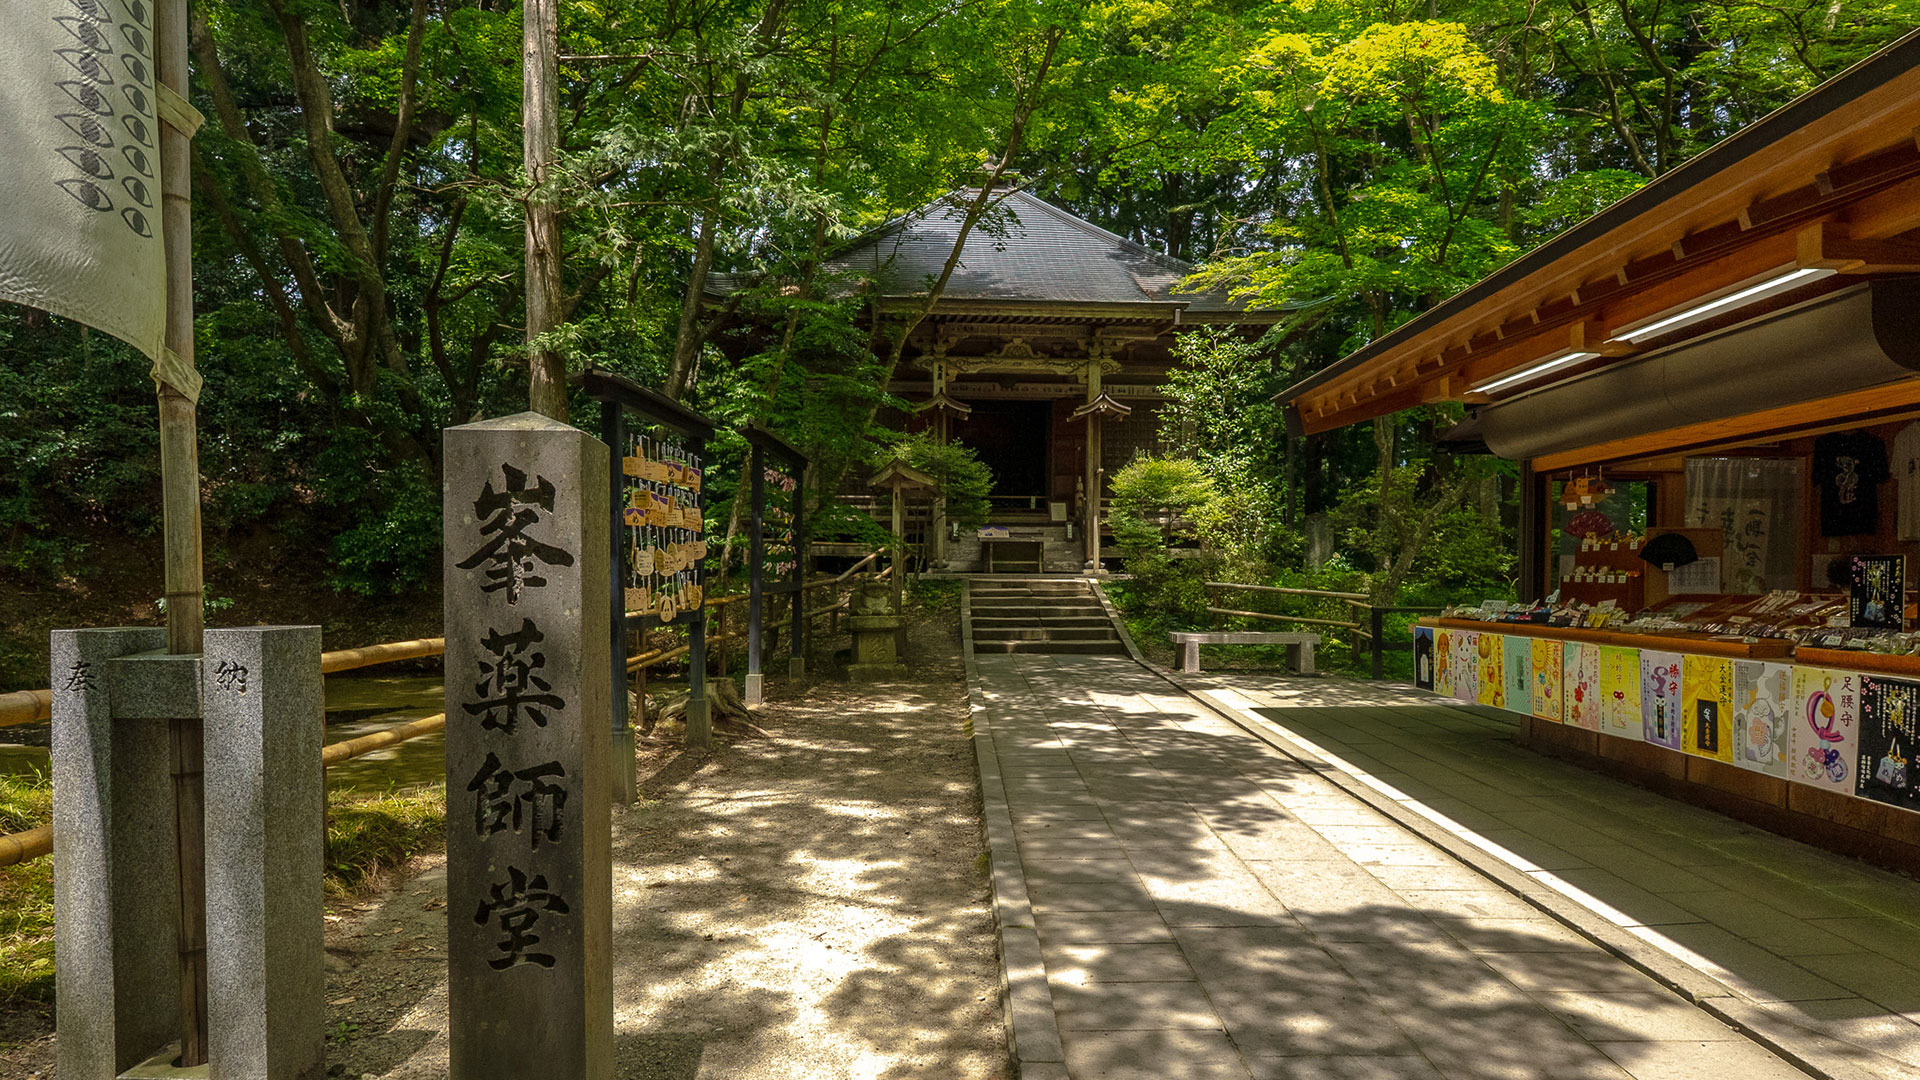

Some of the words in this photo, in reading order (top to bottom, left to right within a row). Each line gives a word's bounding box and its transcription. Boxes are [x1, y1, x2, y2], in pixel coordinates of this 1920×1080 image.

[66, 660, 97, 693] 奉
[214, 660, 248, 695] 納
[455, 462, 574, 971] 峯薬師堂
[1840, 676, 1855, 728] 足腰守
